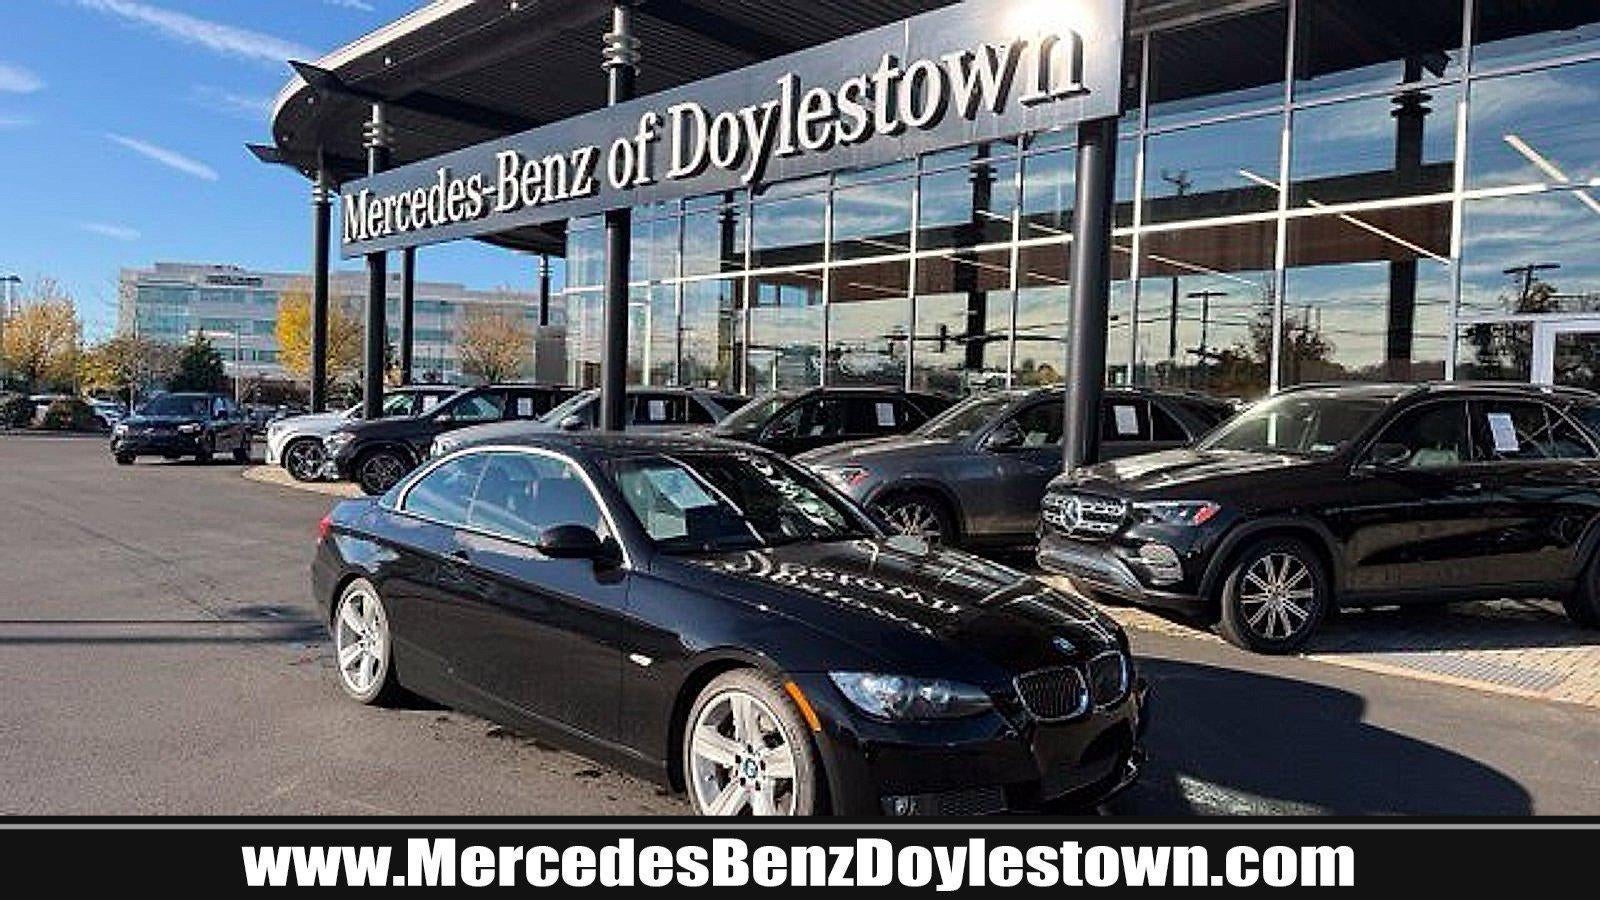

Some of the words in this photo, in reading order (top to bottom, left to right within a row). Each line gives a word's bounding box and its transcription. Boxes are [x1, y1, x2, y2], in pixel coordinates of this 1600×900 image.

[342, 144, 600, 244] Mercedes-Benz
[607, 111, 661, 189] of
[666, 27, 1086, 186] Doylestown
